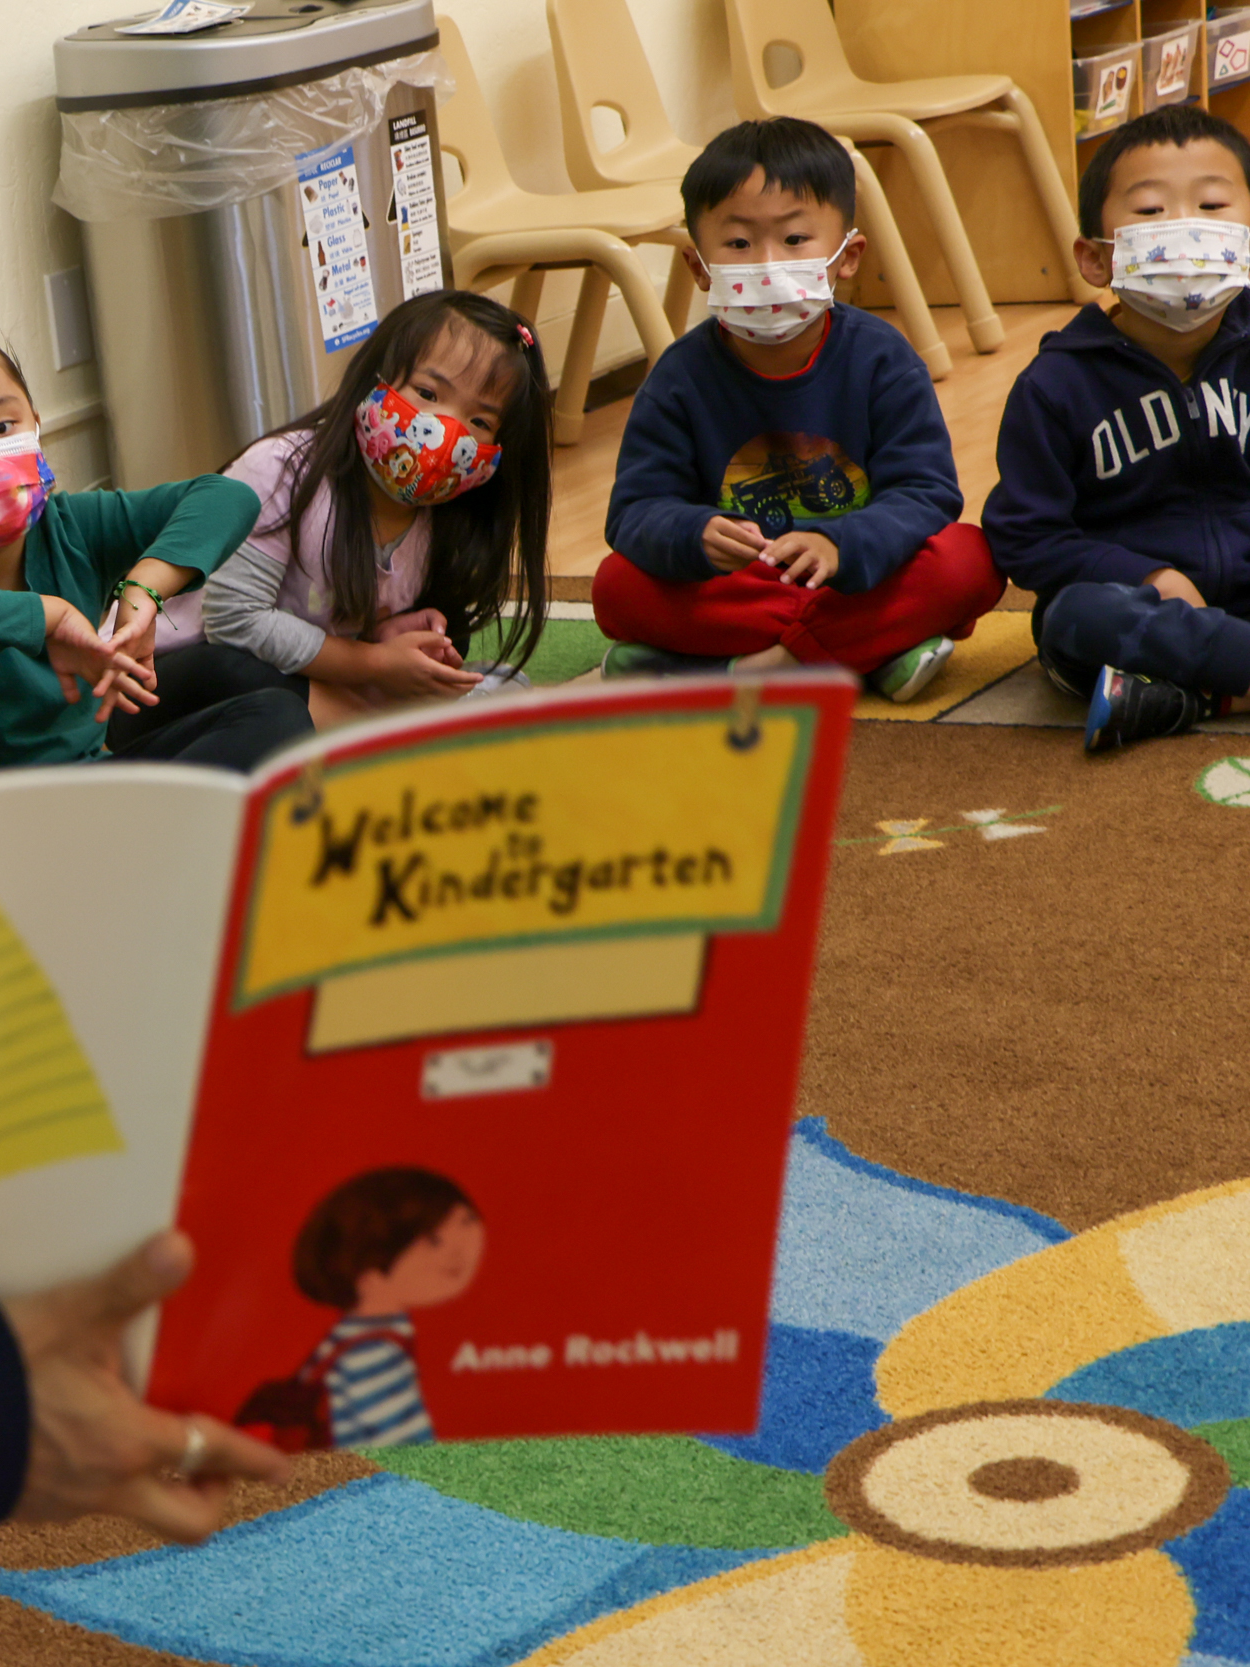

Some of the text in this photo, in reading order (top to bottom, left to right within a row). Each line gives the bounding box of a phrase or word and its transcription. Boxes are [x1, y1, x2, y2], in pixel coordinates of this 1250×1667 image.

[318, 177, 338, 191] Paper
[323, 203, 345, 219] Plastic
[327, 234, 346, 247] Glass
[332, 258, 351, 276] Metal
[1092, 389, 1181, 480] OLD
[308, 788, 541, 889] Welcome
[505, 829, 544, 863] to
[368, 843, 735, 929] Kindergarten
[451, 1328, 739, 1373] Anne Rockwell
